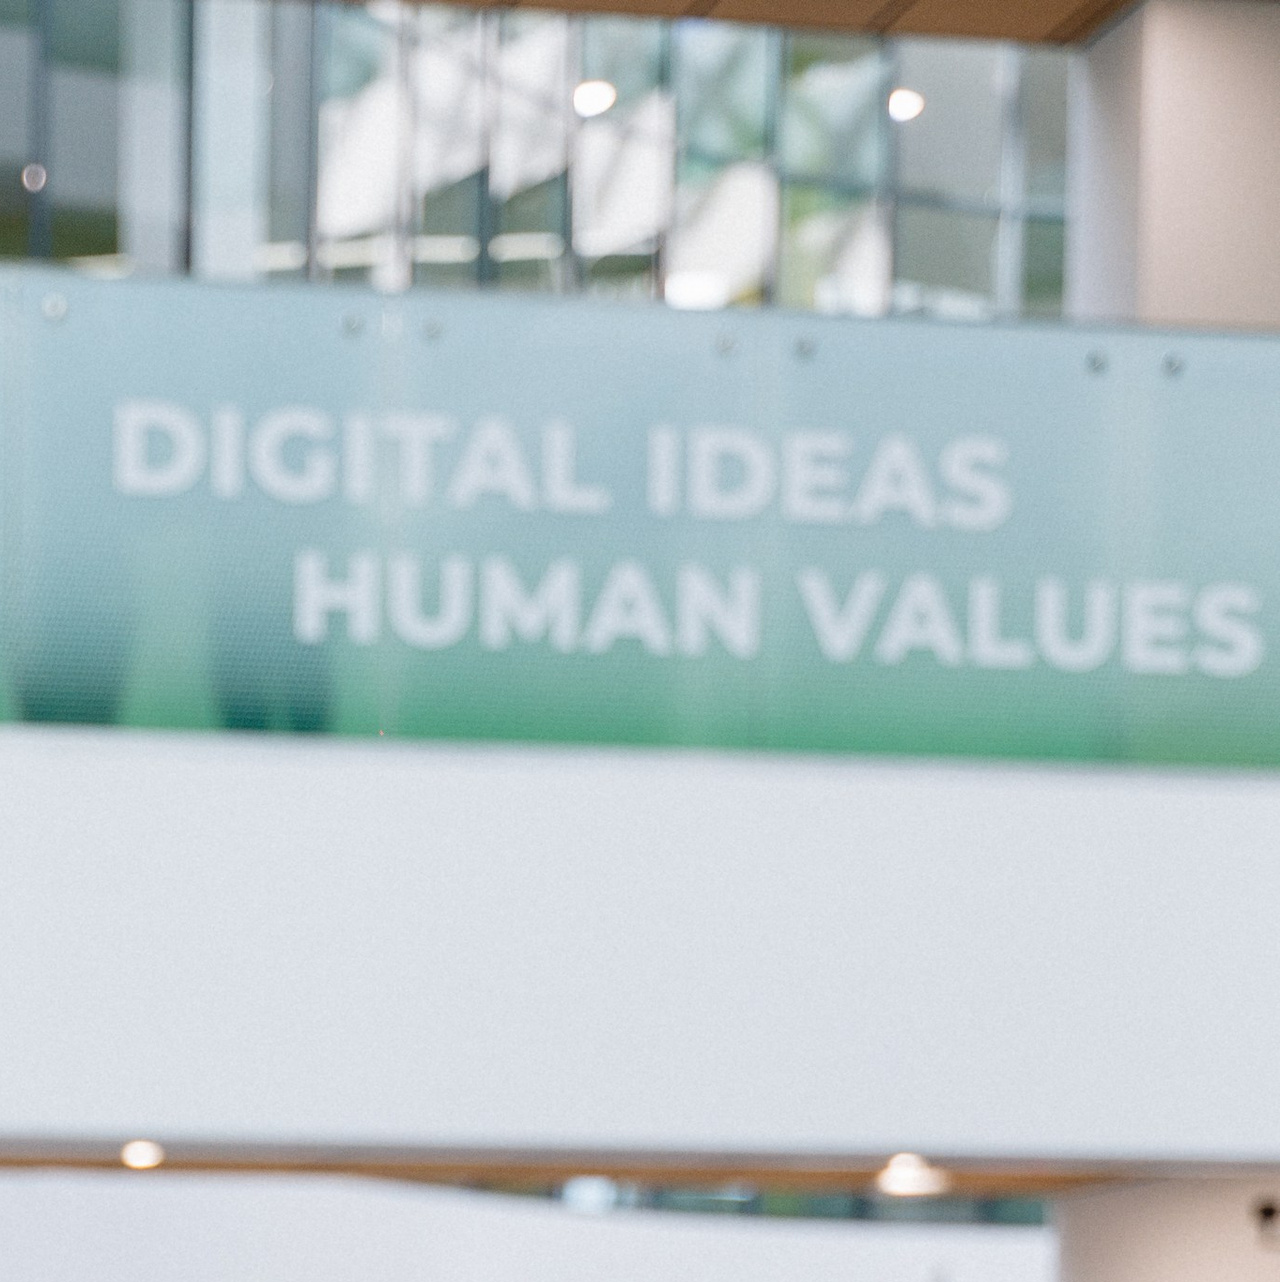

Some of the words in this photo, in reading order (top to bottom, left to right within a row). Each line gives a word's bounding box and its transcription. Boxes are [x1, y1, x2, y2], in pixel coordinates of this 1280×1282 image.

[114, 399, 611, 513] DIGITAL
[646, 422, 1014, 532] IDEAS
[293, 550, 762, 660] HUMAN
[798, 567, 1266, 678] VALUES
